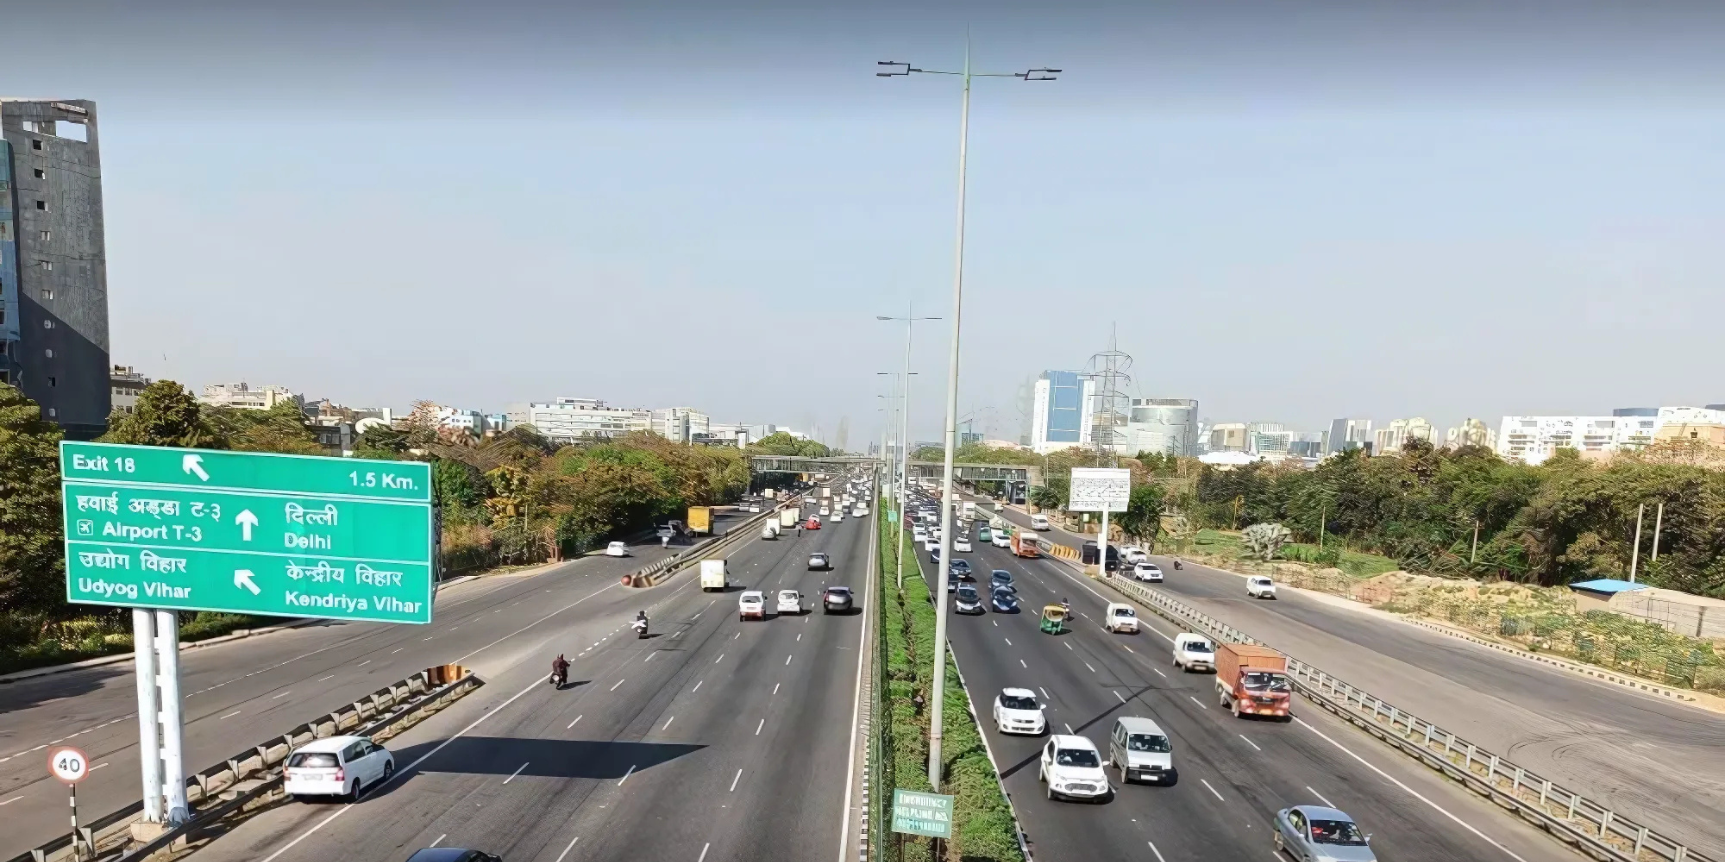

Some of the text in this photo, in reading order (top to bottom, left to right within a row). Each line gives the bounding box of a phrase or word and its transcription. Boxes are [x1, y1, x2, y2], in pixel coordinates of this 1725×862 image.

[73, 454, 136, 473] Exit 18
[349, 471, 419, 490] 1.5 Km.
[76, 491, 119, 515] हवाई
[190, 501, 221, 521] ट-३
[285, 502, 338, 526] दिल्ली
[102, 521, 202, 542] Airport T-3
[284, 532, 331, 550] Delhi
[79, 548, 187, 573] उद्योग विहार
[285, 560, 403, 587] केन्द्रीय विहार
[78, 577, 192, 599] Udyog Vihar
[285, 590, 422, 614] Kendriya Vihar
[58, 757, 80, 773] 40
